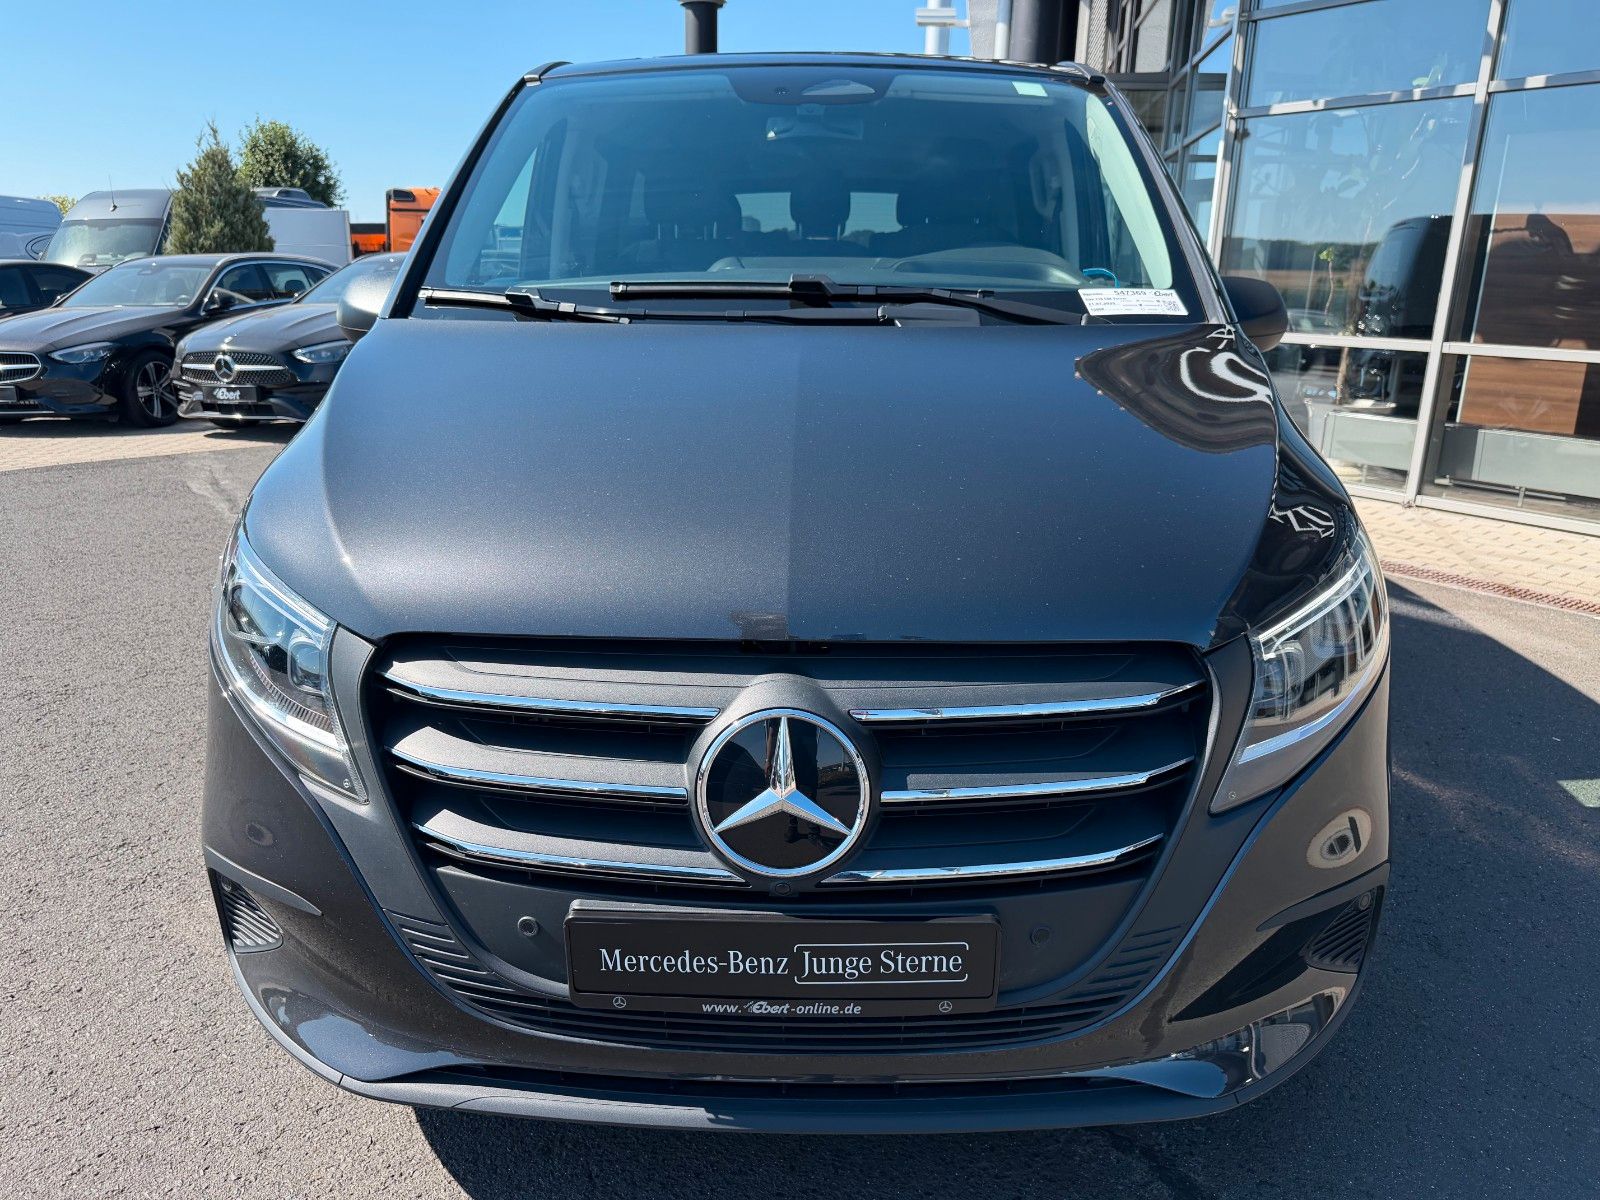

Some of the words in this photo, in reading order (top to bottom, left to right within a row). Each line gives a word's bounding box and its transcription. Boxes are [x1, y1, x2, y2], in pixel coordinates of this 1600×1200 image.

[216, 387, 241, 400] Ebert
[599, 948, 789, 975] Mercedes-Benz
[800, 950, 872, 980] Junge
[879, 949, 962, 974] Sterne
